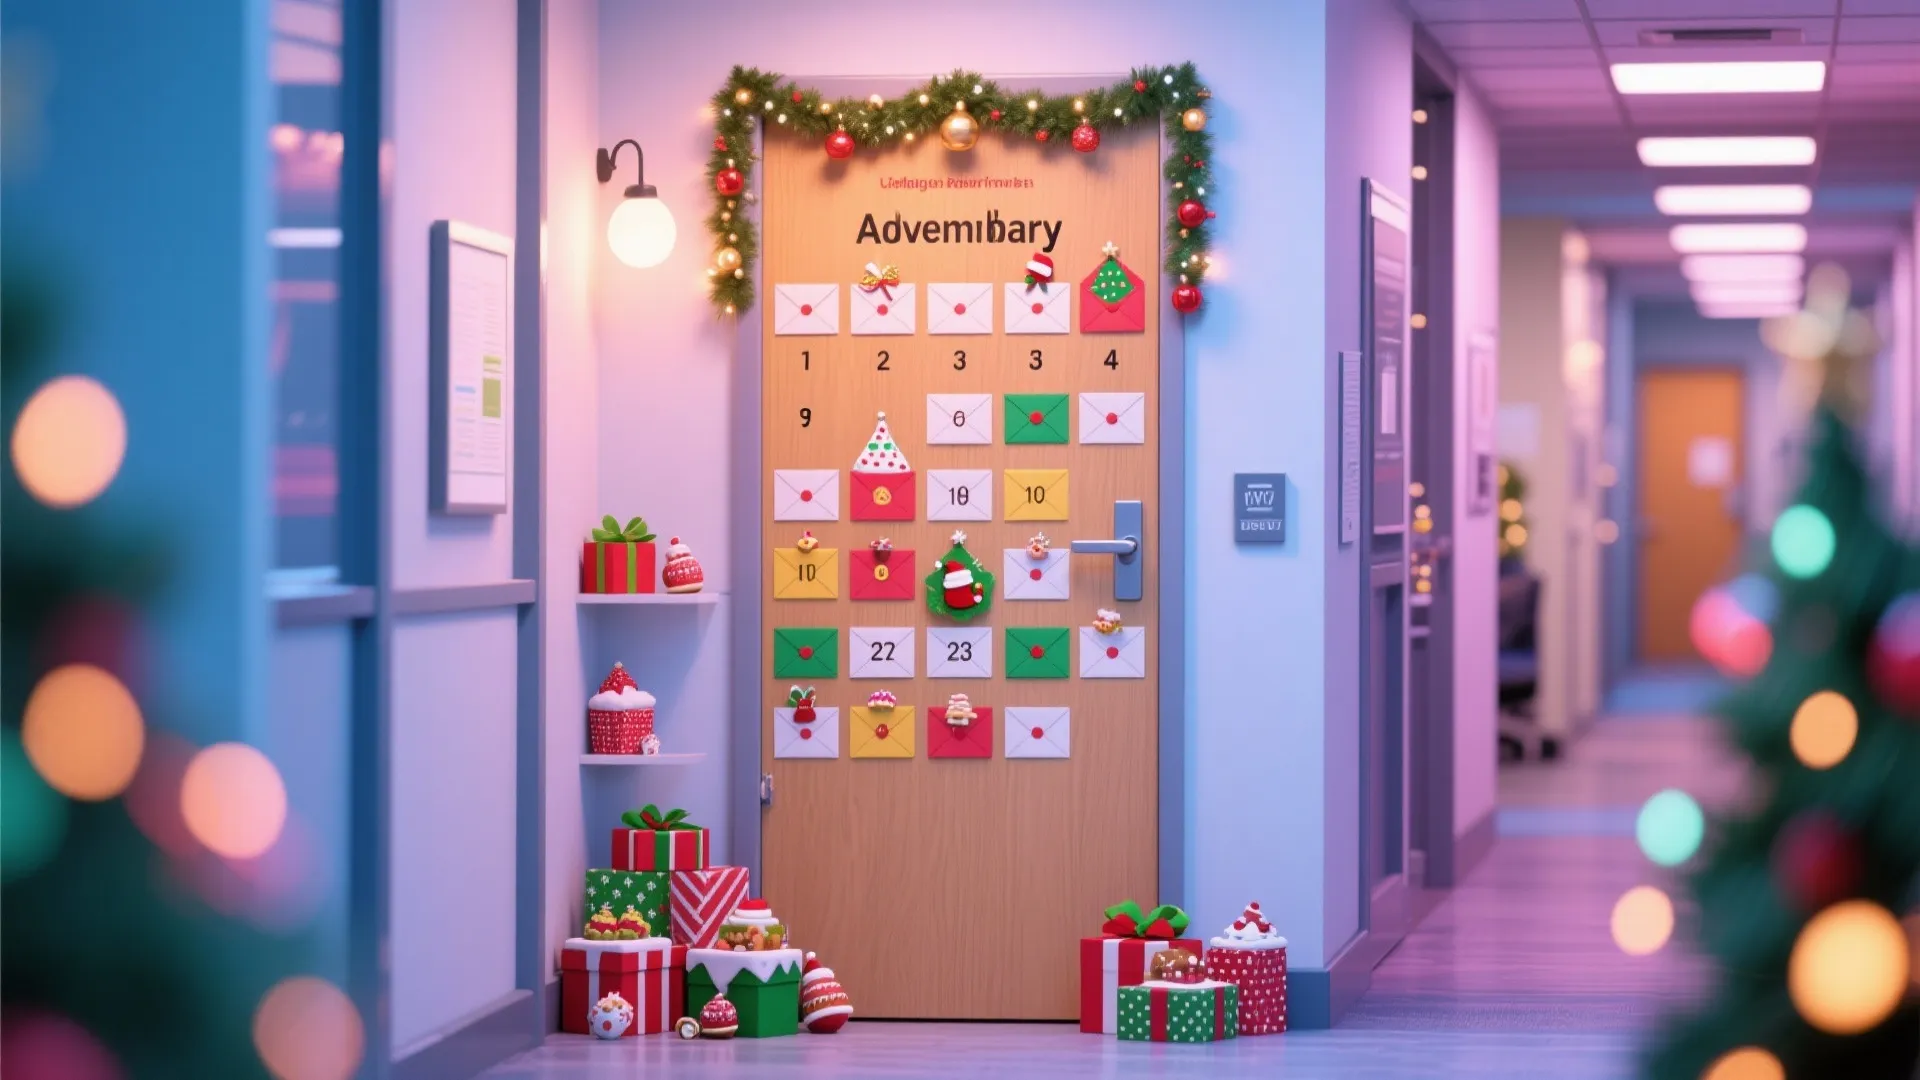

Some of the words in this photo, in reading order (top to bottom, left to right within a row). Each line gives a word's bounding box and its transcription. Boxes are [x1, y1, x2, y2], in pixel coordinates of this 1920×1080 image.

[800, 350, 810, 371] 1
[876, 350, 890, 371] 2
[953, 350, 967, 371] 3
[1029, 349, 1043, 371] 3
[1103, 349, 1119, 371] 4
[799, 407, 812, 428] 9
[1025, 485, 1046, 505] 10
[870, 641, 896, 662] 22
[947, 641, 973, 662] 23
